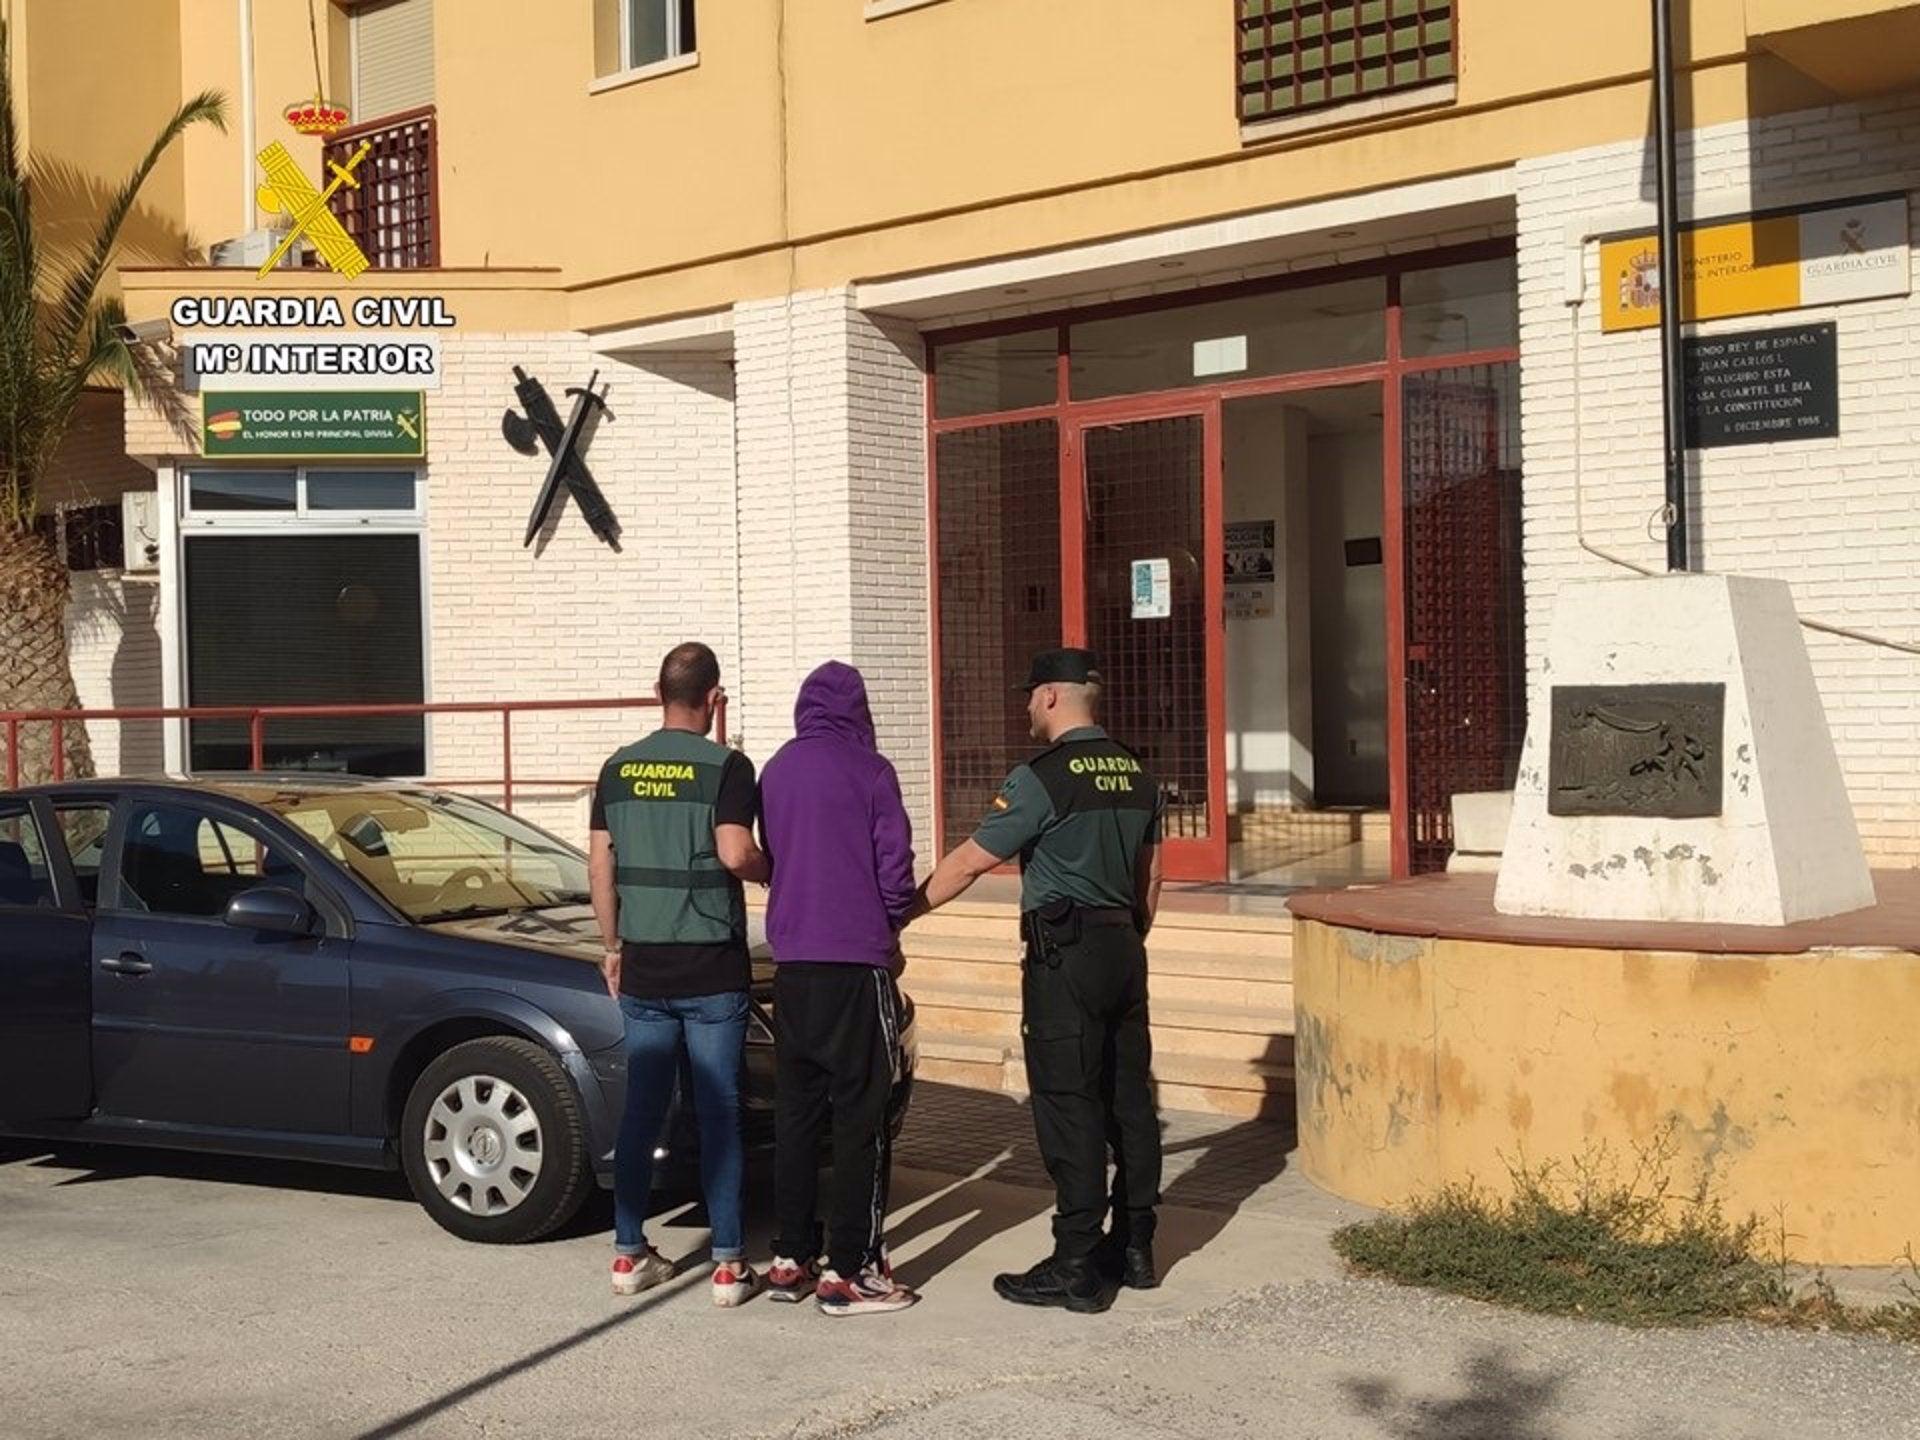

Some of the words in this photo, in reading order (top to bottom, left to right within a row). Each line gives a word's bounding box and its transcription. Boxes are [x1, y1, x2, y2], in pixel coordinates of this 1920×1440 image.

[1807, 258, 1863, 275] GUARDIA
[1866, 253, 1899, 267] CIVIL
[1728, 341, 1750, 353] REY
[1755, 339, 1768, 350] DE
[1773, 333, 1817, 349] ESPAÑA
[1700, 359, 1729, 372] JUAN
[1733, 353, 1774, 367] CARLOS
[1763, 367, 1792, 380] ESTA
[1720, 385, 1770, 399] CUARTEL
[1775, 383, 1787, 393] EL
[1792, 380, 1813, 393] DIA
[242, 409, 285, 422] TODO
[289, 409, 319, 422] POR
[322, 409, 340, 422] LA
[343, 409, 393, 422] PATRIA
[1705, 404, 1721, 416] LA
[243, 430, 254, 439] EL
[255, 430, 289, 439] HONOR
[291, 430, 303, 439] ES
[316, 430, 362, 439] PRINCIPAL
[364, 430, 394, 439] DIVISA
[619, 763, 695, 780] GUARDIA
[1069, 757, 1143, 774] GUARDIA
[633, 780, 677, 798] CIVIL
[1095, 775, 1133, 792] CIVIL
